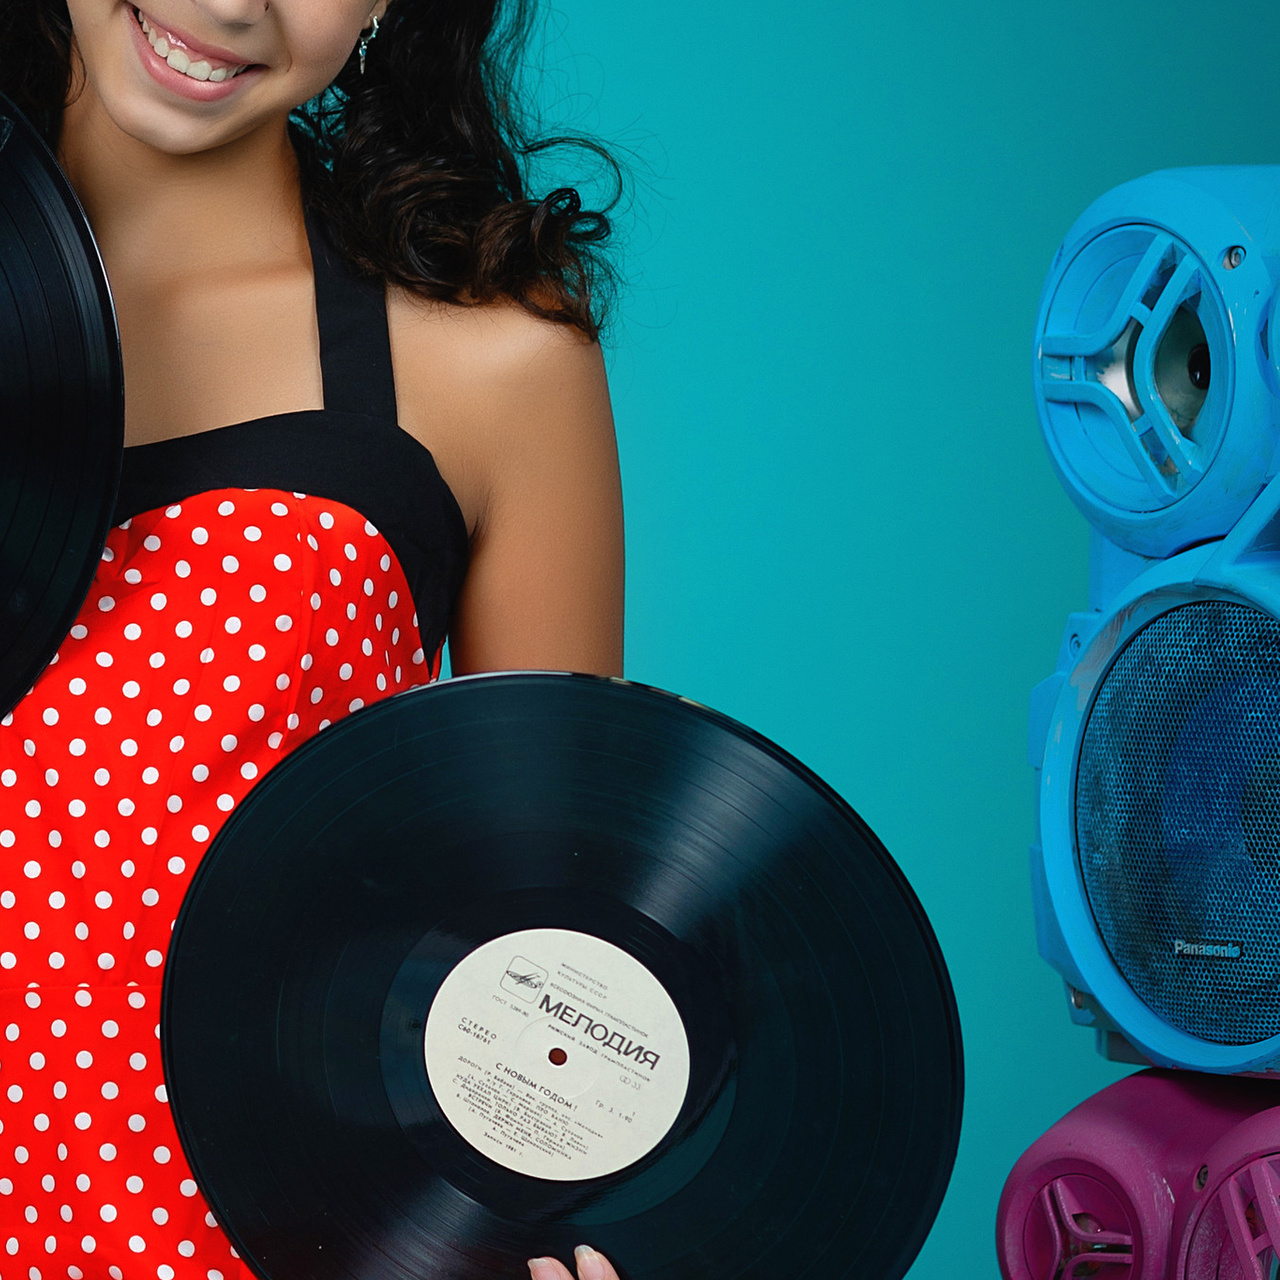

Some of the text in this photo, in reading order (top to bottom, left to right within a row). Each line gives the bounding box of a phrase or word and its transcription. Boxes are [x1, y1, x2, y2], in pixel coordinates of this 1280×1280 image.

[1174, 939, 1241, 958] Panasonic
[491, 994, 507, 1005] ГОСТ
[460, 1016, 497, 1039] СТЕРЕО
[537, 993, 661, 1071] МЕЛОДИЯ
[503, 1066, 538, 1089] НОВЫМ
[538, 1085, 573, 1109] ГОДОМ
